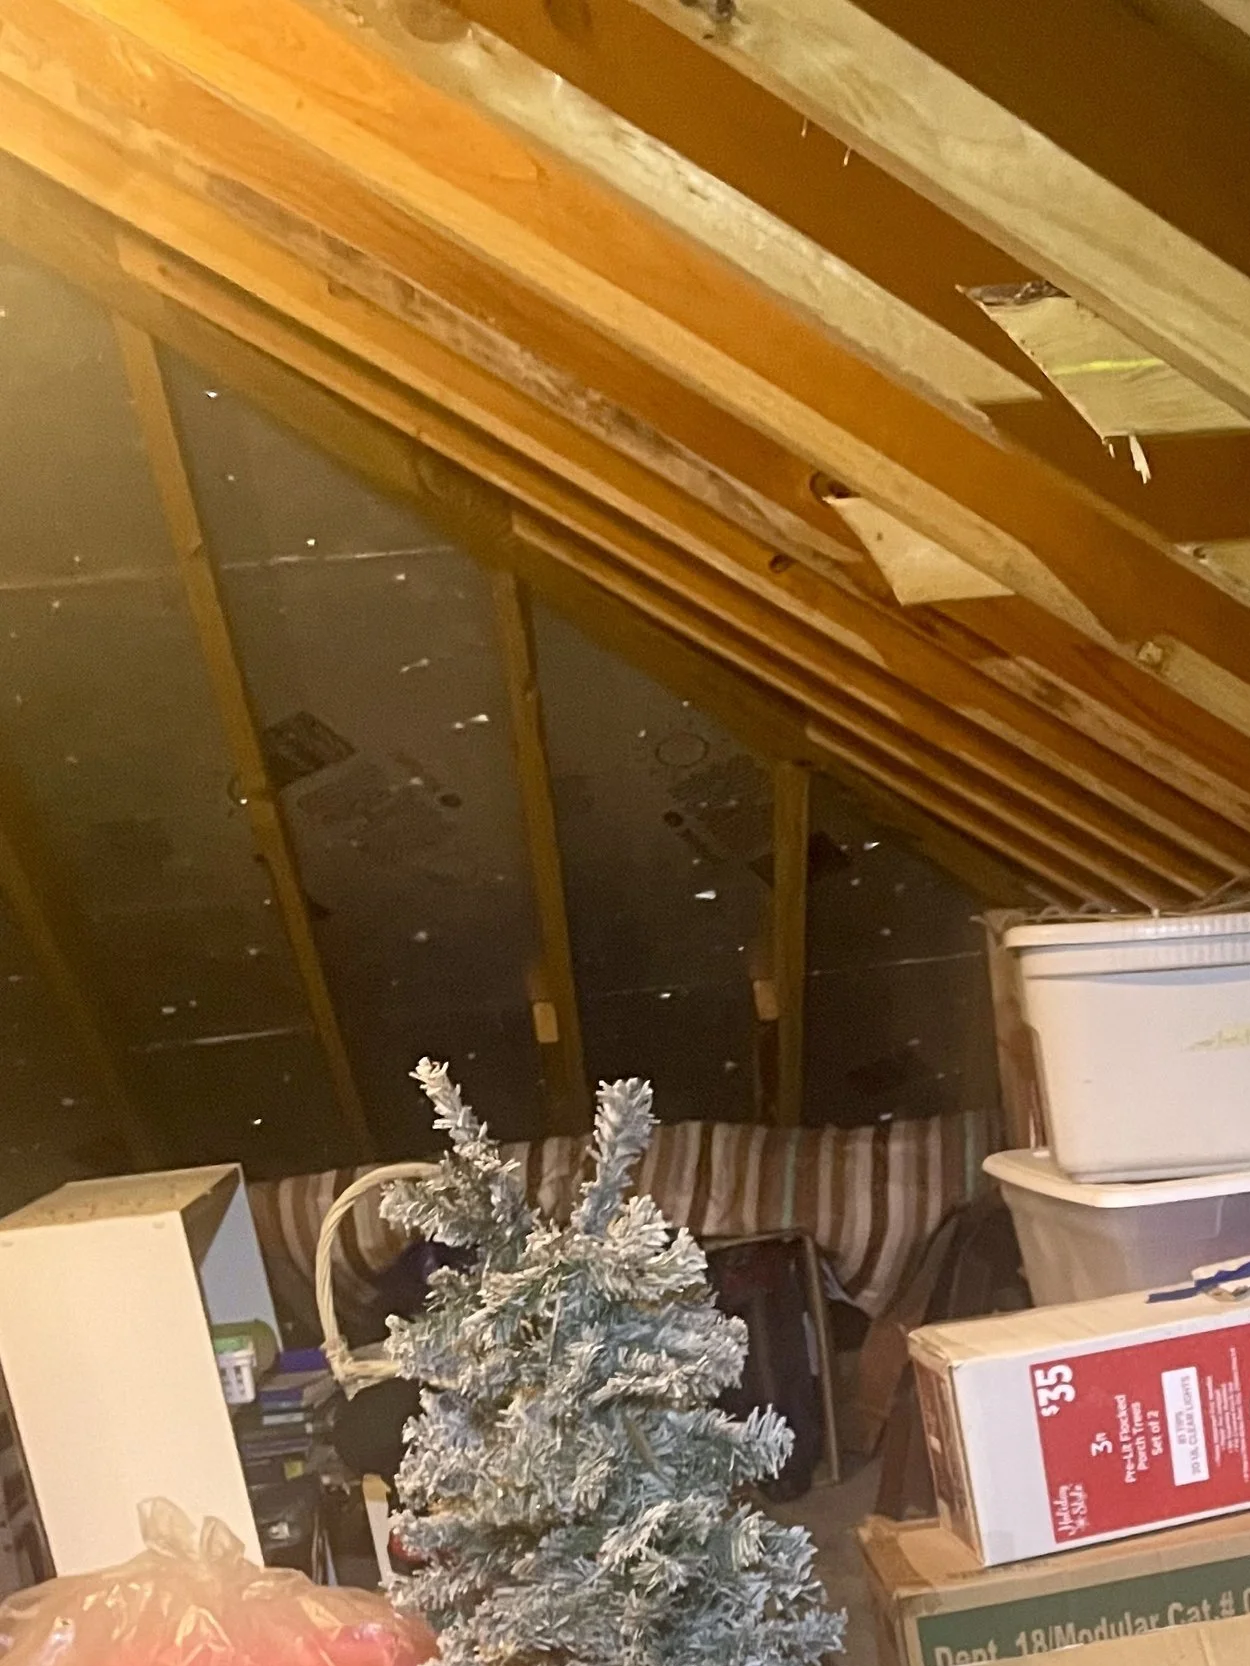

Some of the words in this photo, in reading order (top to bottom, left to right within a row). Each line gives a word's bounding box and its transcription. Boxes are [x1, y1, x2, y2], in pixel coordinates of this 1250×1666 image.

[1033, 1364, 1076, 1418] $35
[1113, 1394, 1132, 1442] Flocked
[1149, 1420, 1162, 1434] of
[1151, 1434, 1165, 1456] Set
